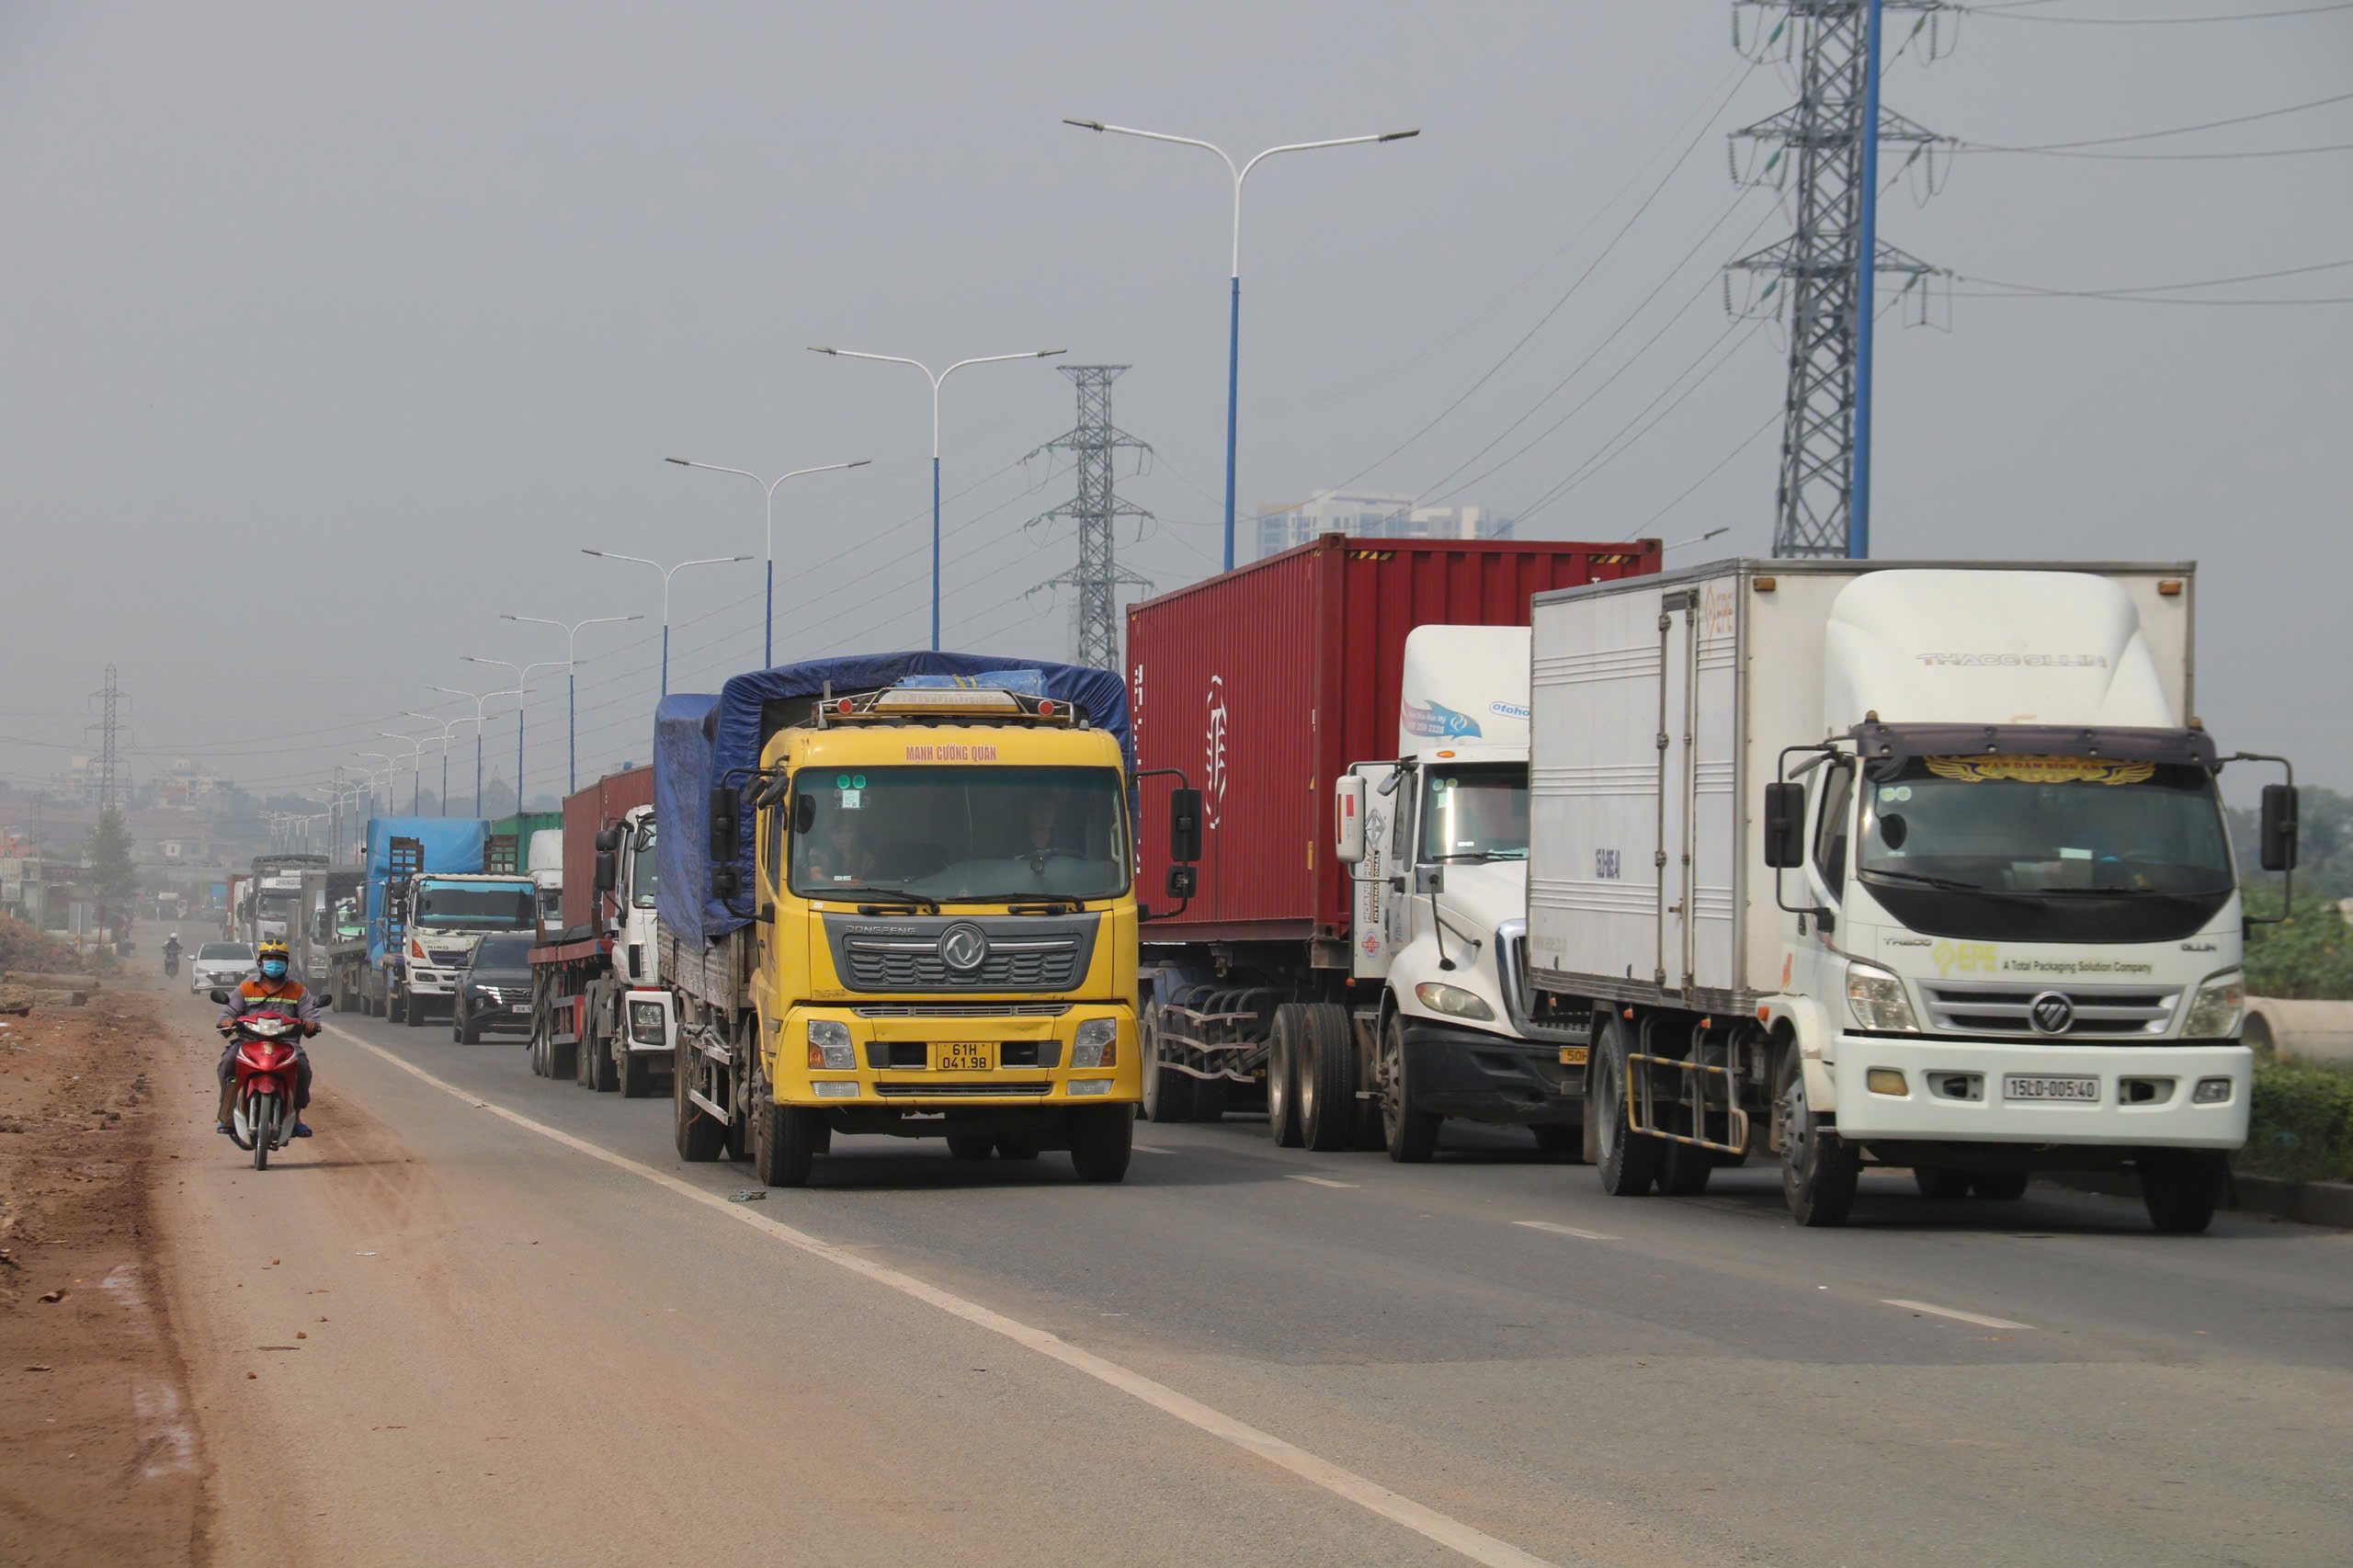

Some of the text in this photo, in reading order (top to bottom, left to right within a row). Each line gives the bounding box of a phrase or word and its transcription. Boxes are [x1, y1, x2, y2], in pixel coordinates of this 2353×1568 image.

[2011, 960, 2031, 971] Total
[2033, 960, 2076, 973] Packaging
[2077, 960, 2111, 972] Solution
[2114, 961, 2153, 975] Company
[952, 1043, 977, 1055] 61H
[943, 1057, 986, 1069] 041.98
